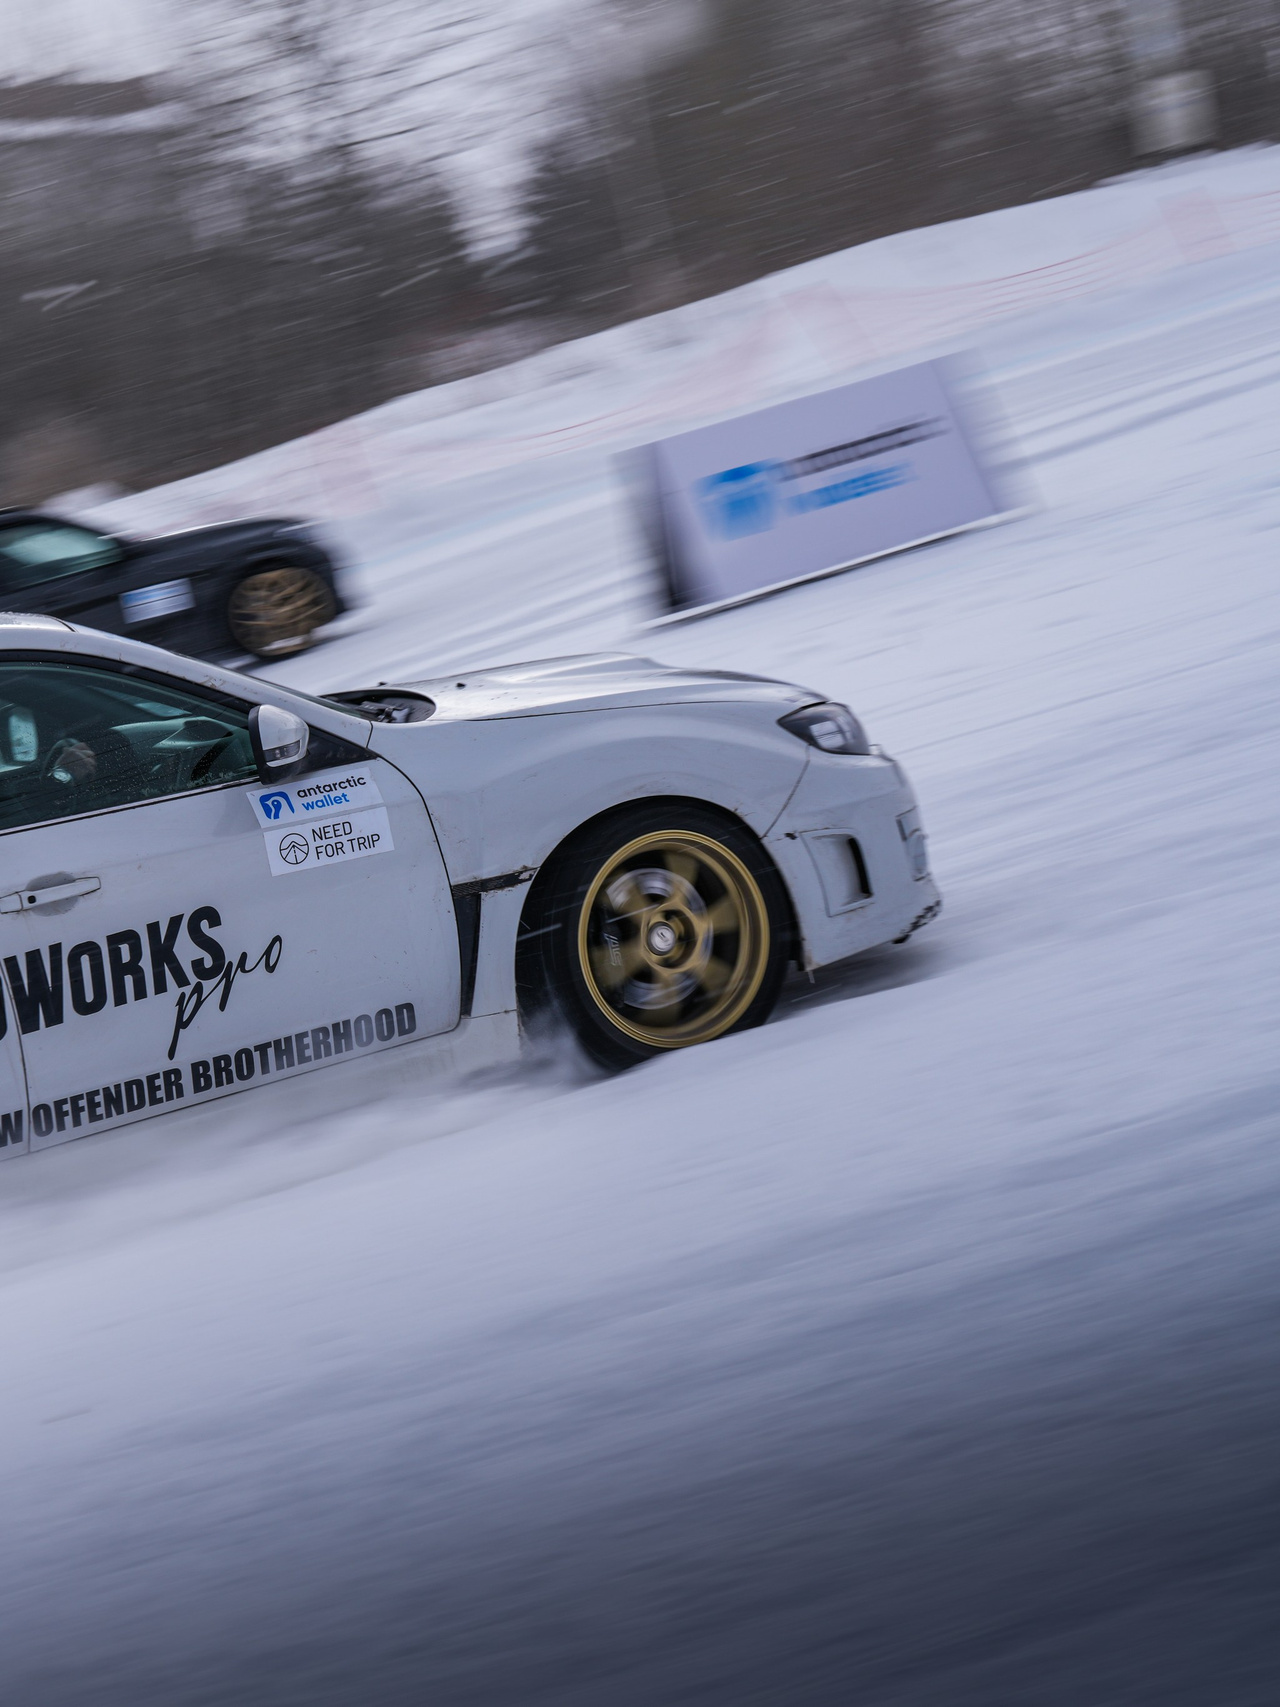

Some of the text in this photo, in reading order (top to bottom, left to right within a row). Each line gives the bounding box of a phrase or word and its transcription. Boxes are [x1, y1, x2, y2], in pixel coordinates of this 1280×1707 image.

[296, 775, 367, 799] antarctic
[301, 792, 350, 811] wallet
[312, 821, 353, 842] NEED
[315, 833, 381, 860] FOR TRIP
[167, 934, 283, 1061] pro
[31, 1067, 185, 1138] OFFENDER
[189, 1001, 418, 1095] BROTHERHOOD
